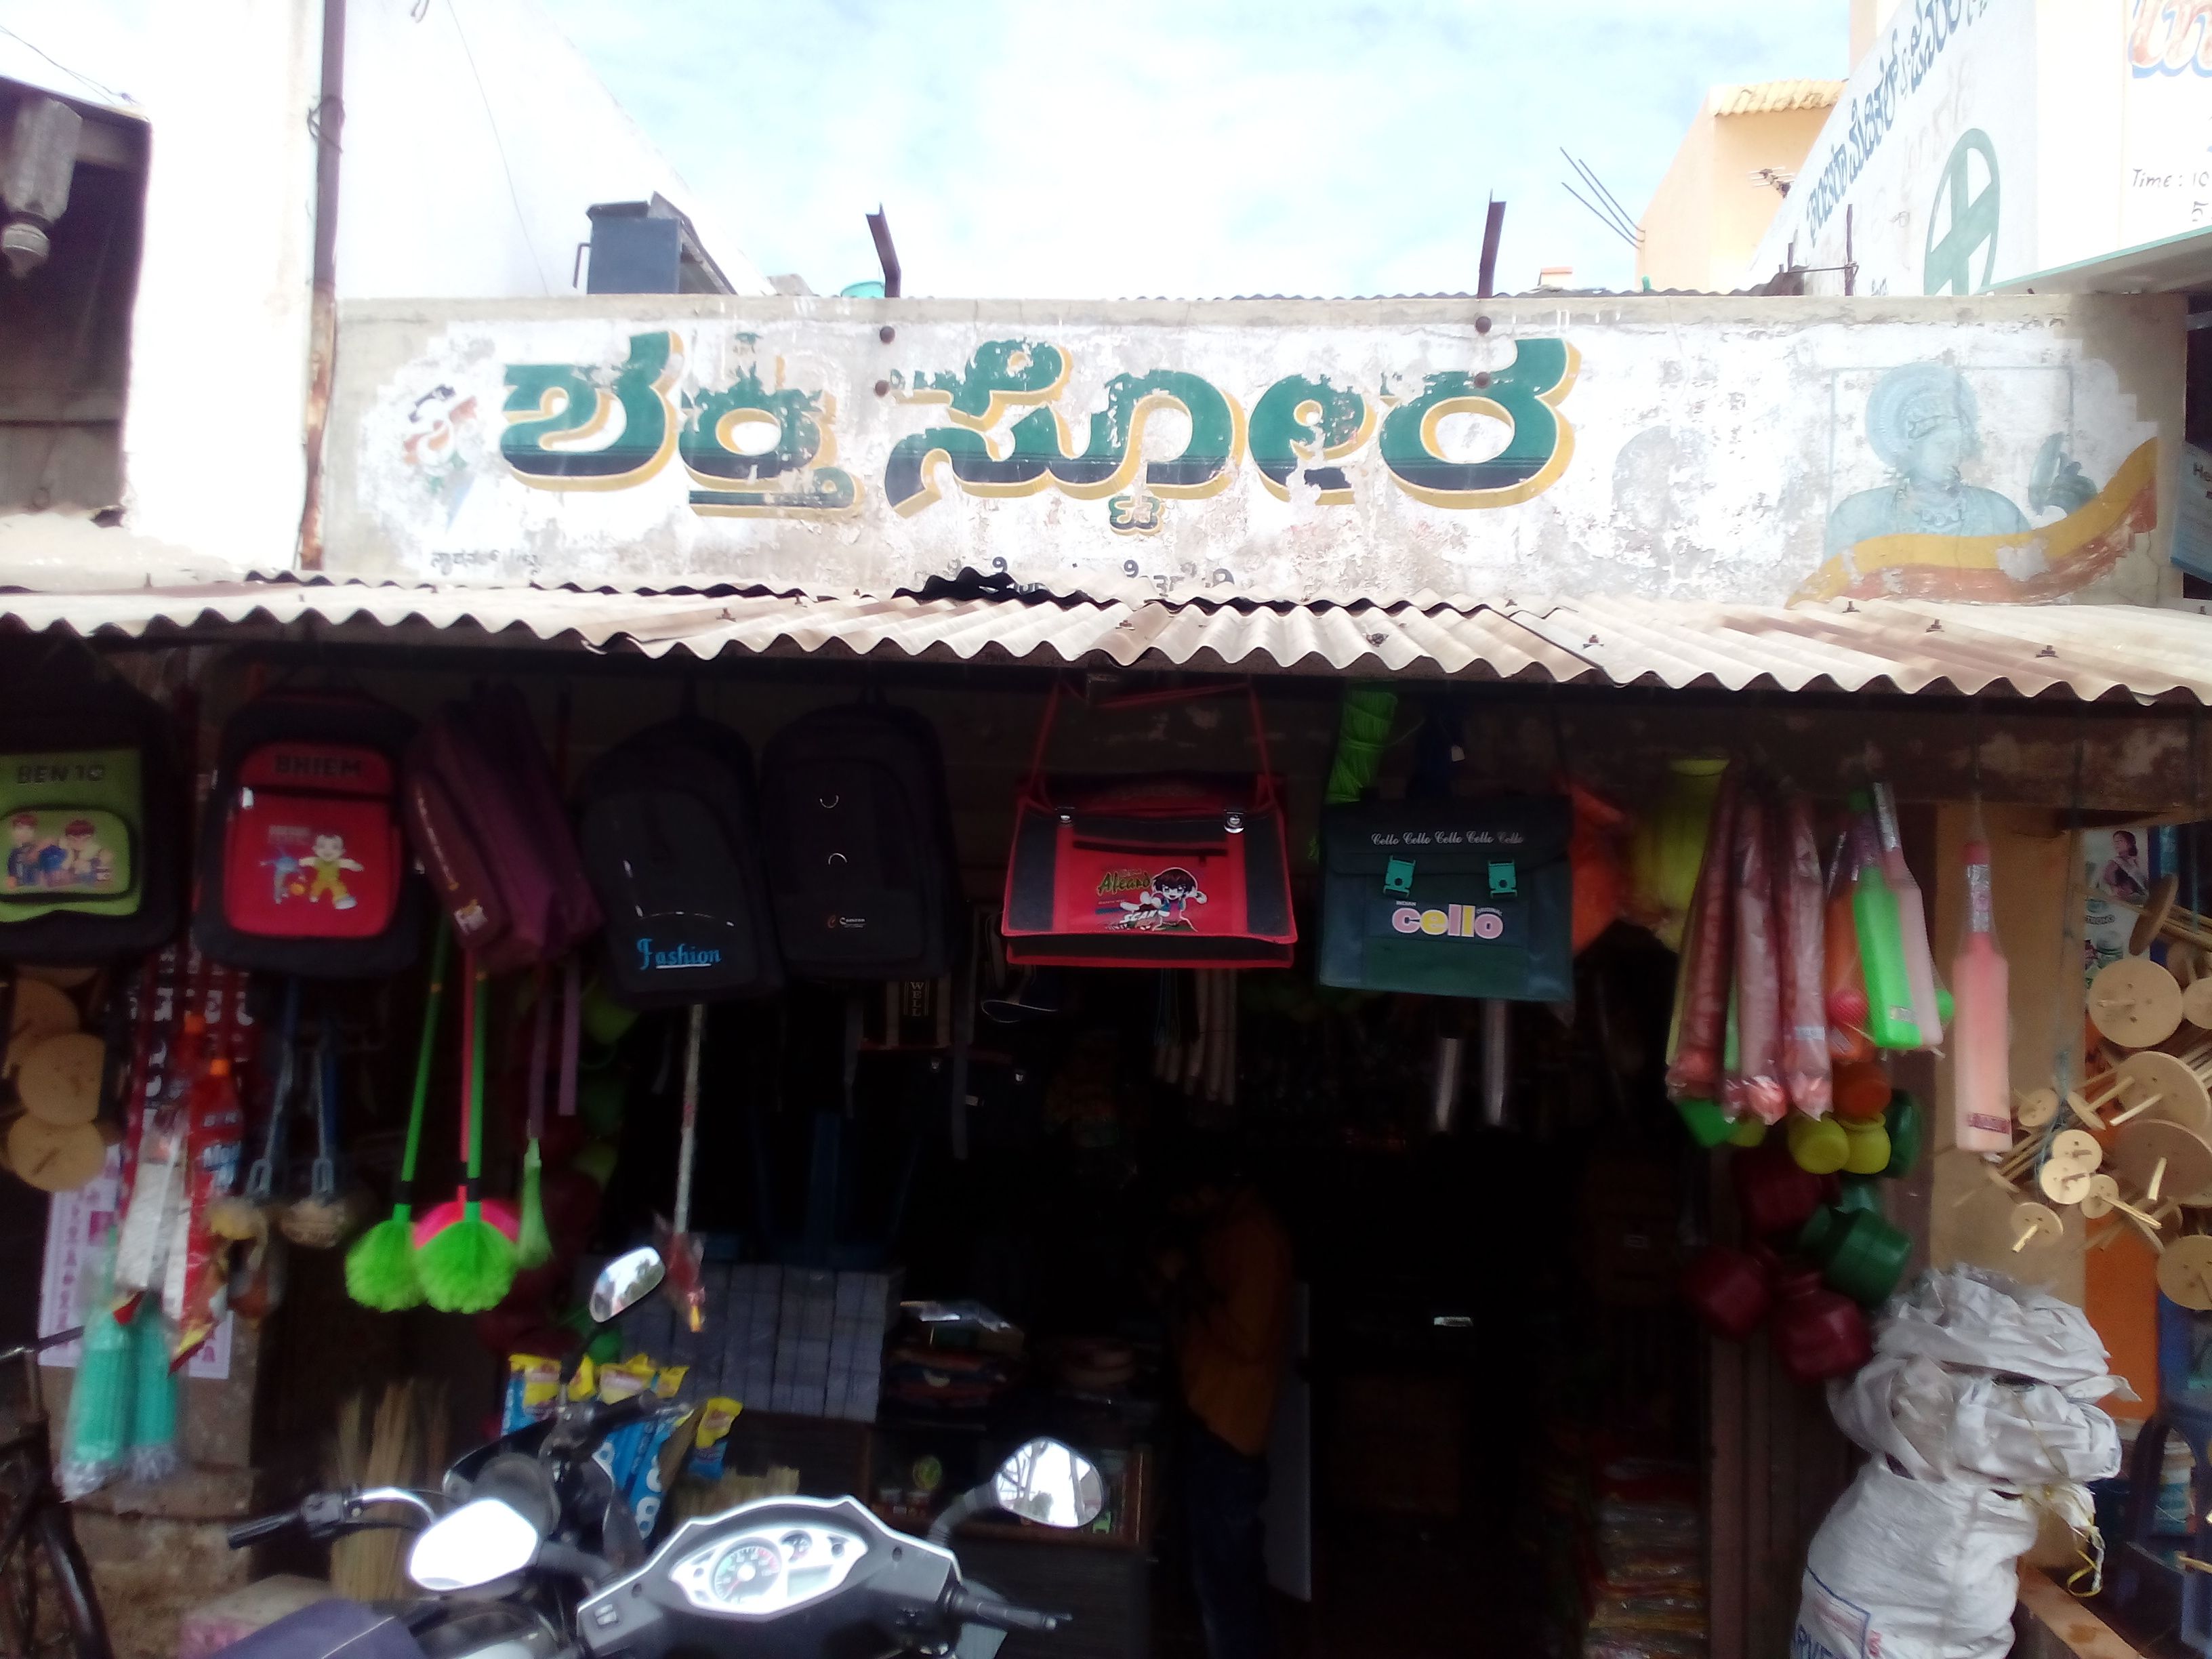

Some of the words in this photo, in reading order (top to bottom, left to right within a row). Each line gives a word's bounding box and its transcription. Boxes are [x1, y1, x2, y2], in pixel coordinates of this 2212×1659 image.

[18, 764, 68, 784] BEN
[75, 763, 106, 782] 10
[1370, 832, 1400, 846] Cello
[1402, 832, 1431, 845] Cello
[1434, 830, 1463, 844] Cello
[1465, 830, 1495, 844] Cello
[1496, 831, 1524, 844] Cello
[1391, 903, 1504, 940] cello
[635, 937, 722, 971] Fashion
